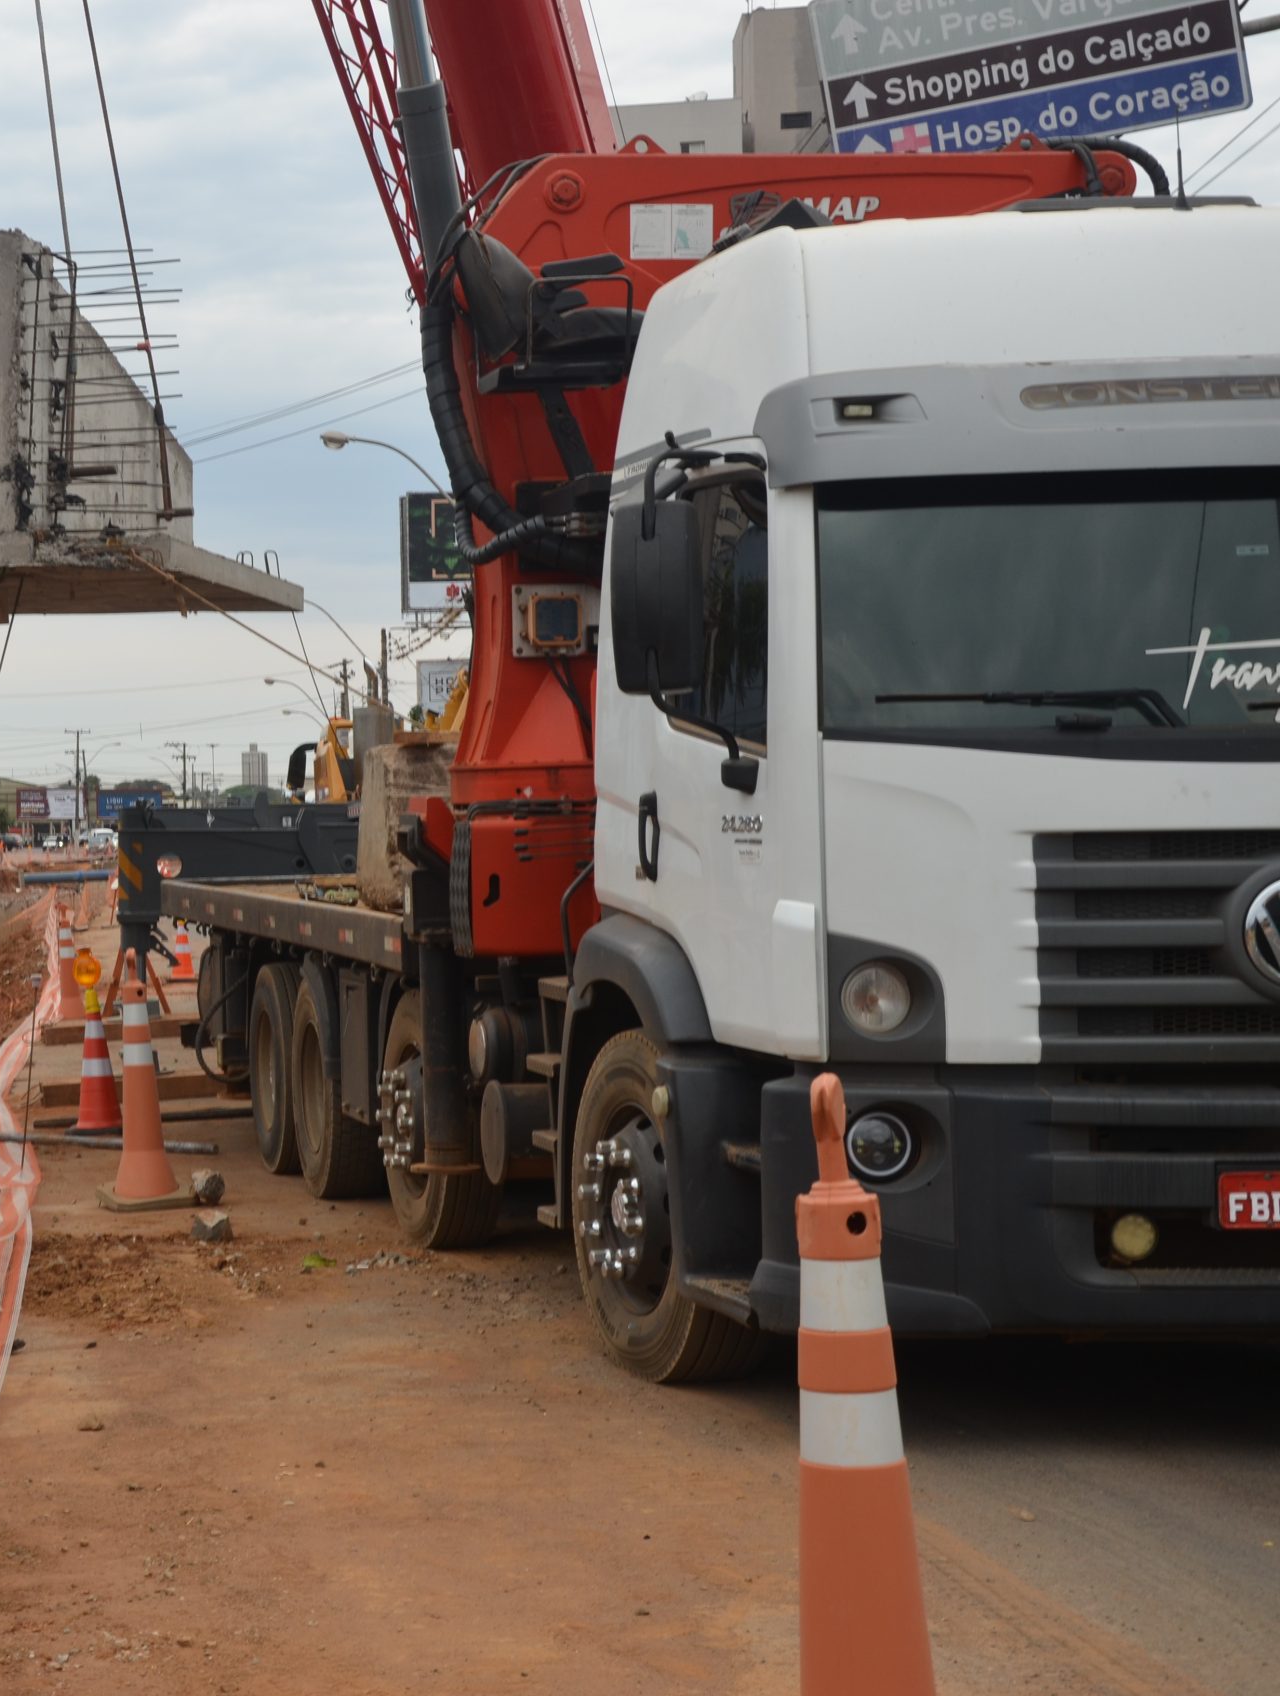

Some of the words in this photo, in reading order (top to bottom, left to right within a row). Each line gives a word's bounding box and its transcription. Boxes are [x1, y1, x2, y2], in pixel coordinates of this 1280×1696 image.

[878, 25, 931, 55] Av.
[939, 6, 1024, 42] Pres.
[1031, 0, 1132, 20] Varg
[884, 58, 1029, 106] Shopping
[1037, 45, 1075, 75] do
[1084, 17, 1211, 65] Calçado
[935, 116, 1030, 151] Hosp.
[1038, 102, 1078, 131] do
[1088, 70, 1230, 122] Coração
[1022, 378, 1280, 410] CONSTE
